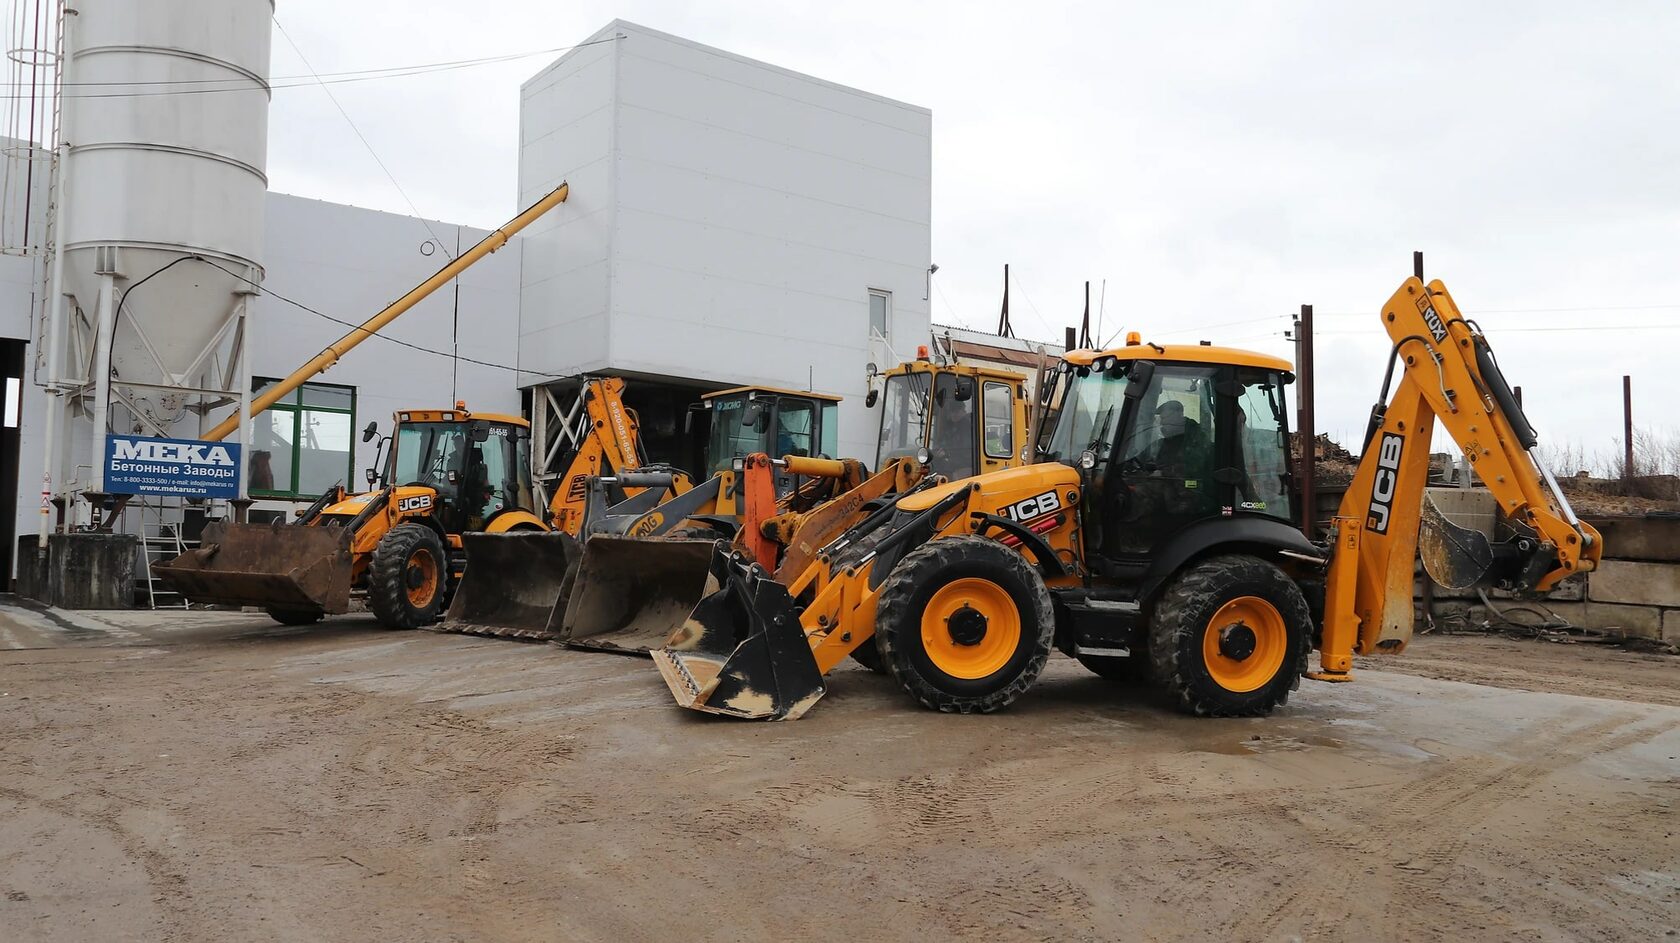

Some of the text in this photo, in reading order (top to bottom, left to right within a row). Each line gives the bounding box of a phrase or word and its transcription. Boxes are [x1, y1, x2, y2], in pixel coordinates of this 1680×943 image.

[112, 439, 235, 467] MEKA
[111, 460, 235, 479] Бетонные Заводы
[124, 476, 168, 485] 8-800-3333-500
[139, 485, 207, 494] www.mekarus.ru
[569, 476, 585, 498] JCB
[1370, 435, 1402, 531] JCB
[399, 495, 431, 511] JCB
[1008, 491, 1060, 522] JCB
